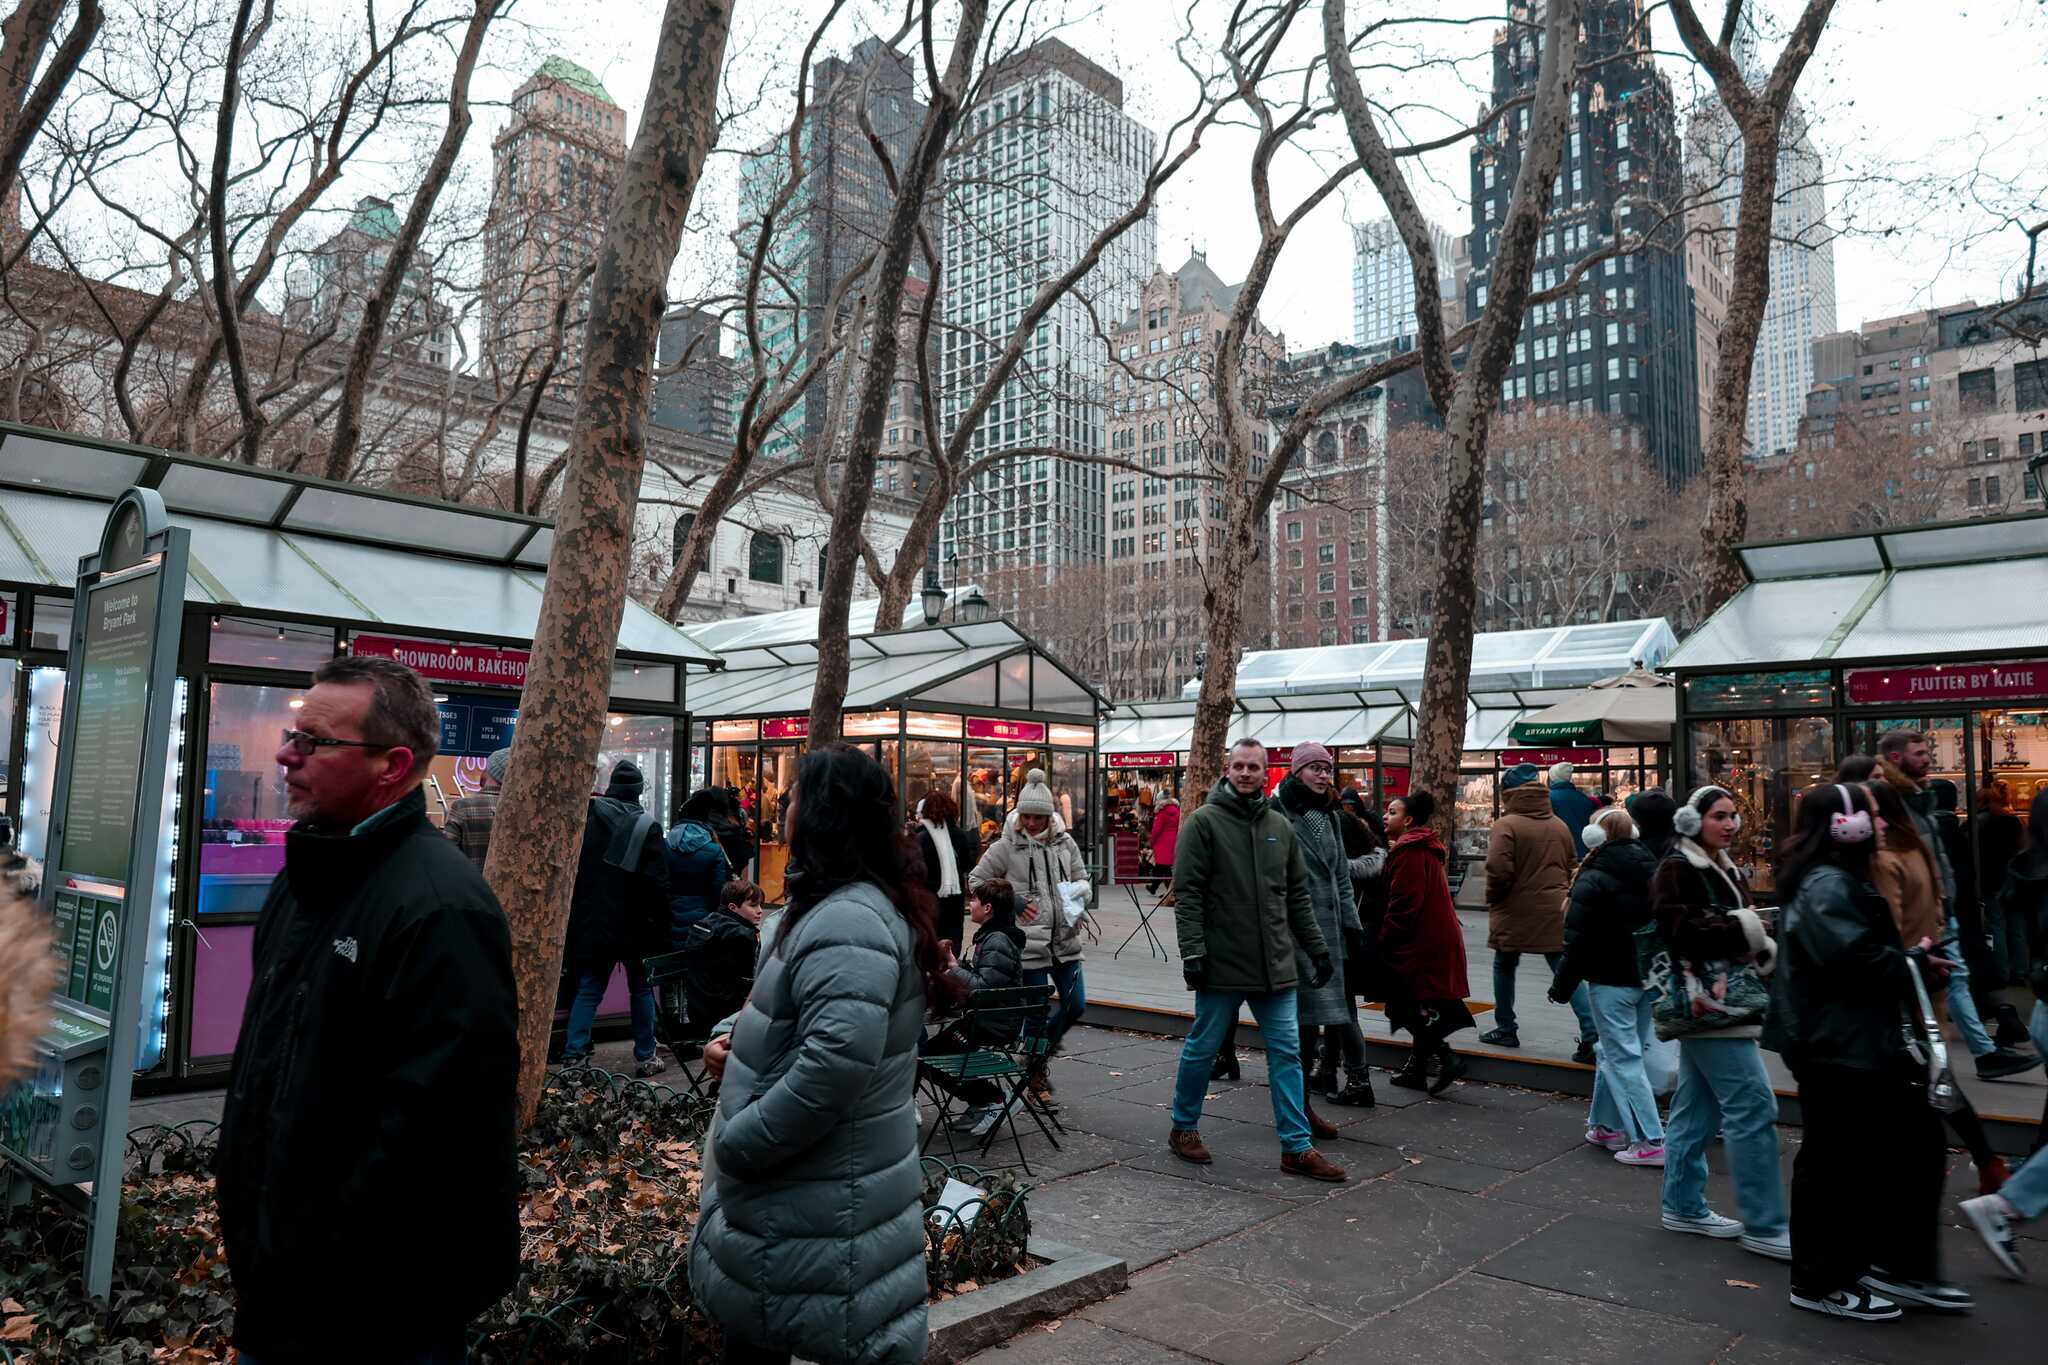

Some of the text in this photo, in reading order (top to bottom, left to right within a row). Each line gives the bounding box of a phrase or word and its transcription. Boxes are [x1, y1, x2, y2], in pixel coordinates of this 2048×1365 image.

[104, 597, 130, 613] Welcome
[103, 609, 137, 631] Bryant Park
[1910, 672, 2034, 691] FLUTTER BY KATIE
[1525, 726, 1585, 736] BRYANT PARK
